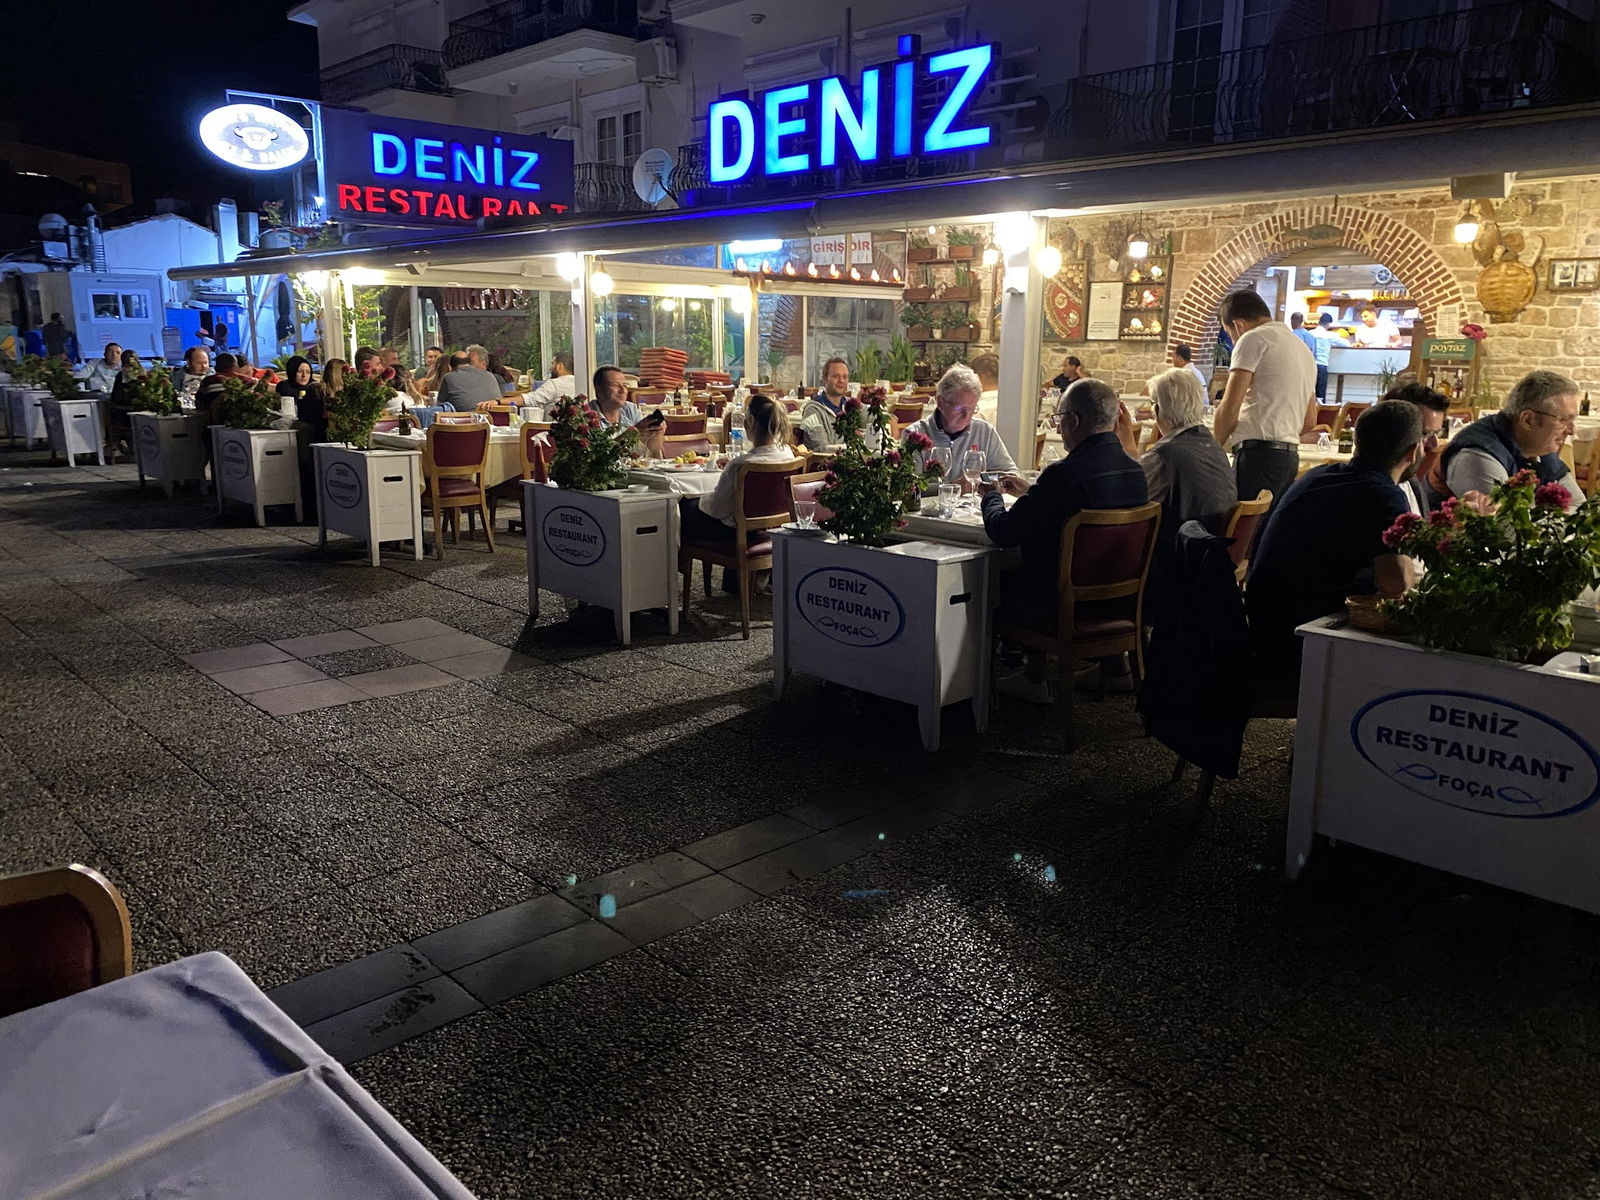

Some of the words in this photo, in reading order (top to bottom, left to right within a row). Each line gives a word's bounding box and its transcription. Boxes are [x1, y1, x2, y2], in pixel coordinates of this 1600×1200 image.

[709, 34, 993, 184] DENİZ
[371, 131, 542, 191] DENİZ
[1429, 344, 1467, 353] poyraz
[560, 513, 584, 526] DENİZ
[548, 527, 598, 545] RESTAURANT
[828, 576, 868, 596] DENİZ
[807, 592, 891, 623] RESTAURANT
[834, 622, 859, 636] FOÇA
[1429, 704, 1520, 739] DENİZ
[1376, 725, 1575, 783] RESTAURANT
[1438, 773, 1495, 800] FOÇA
